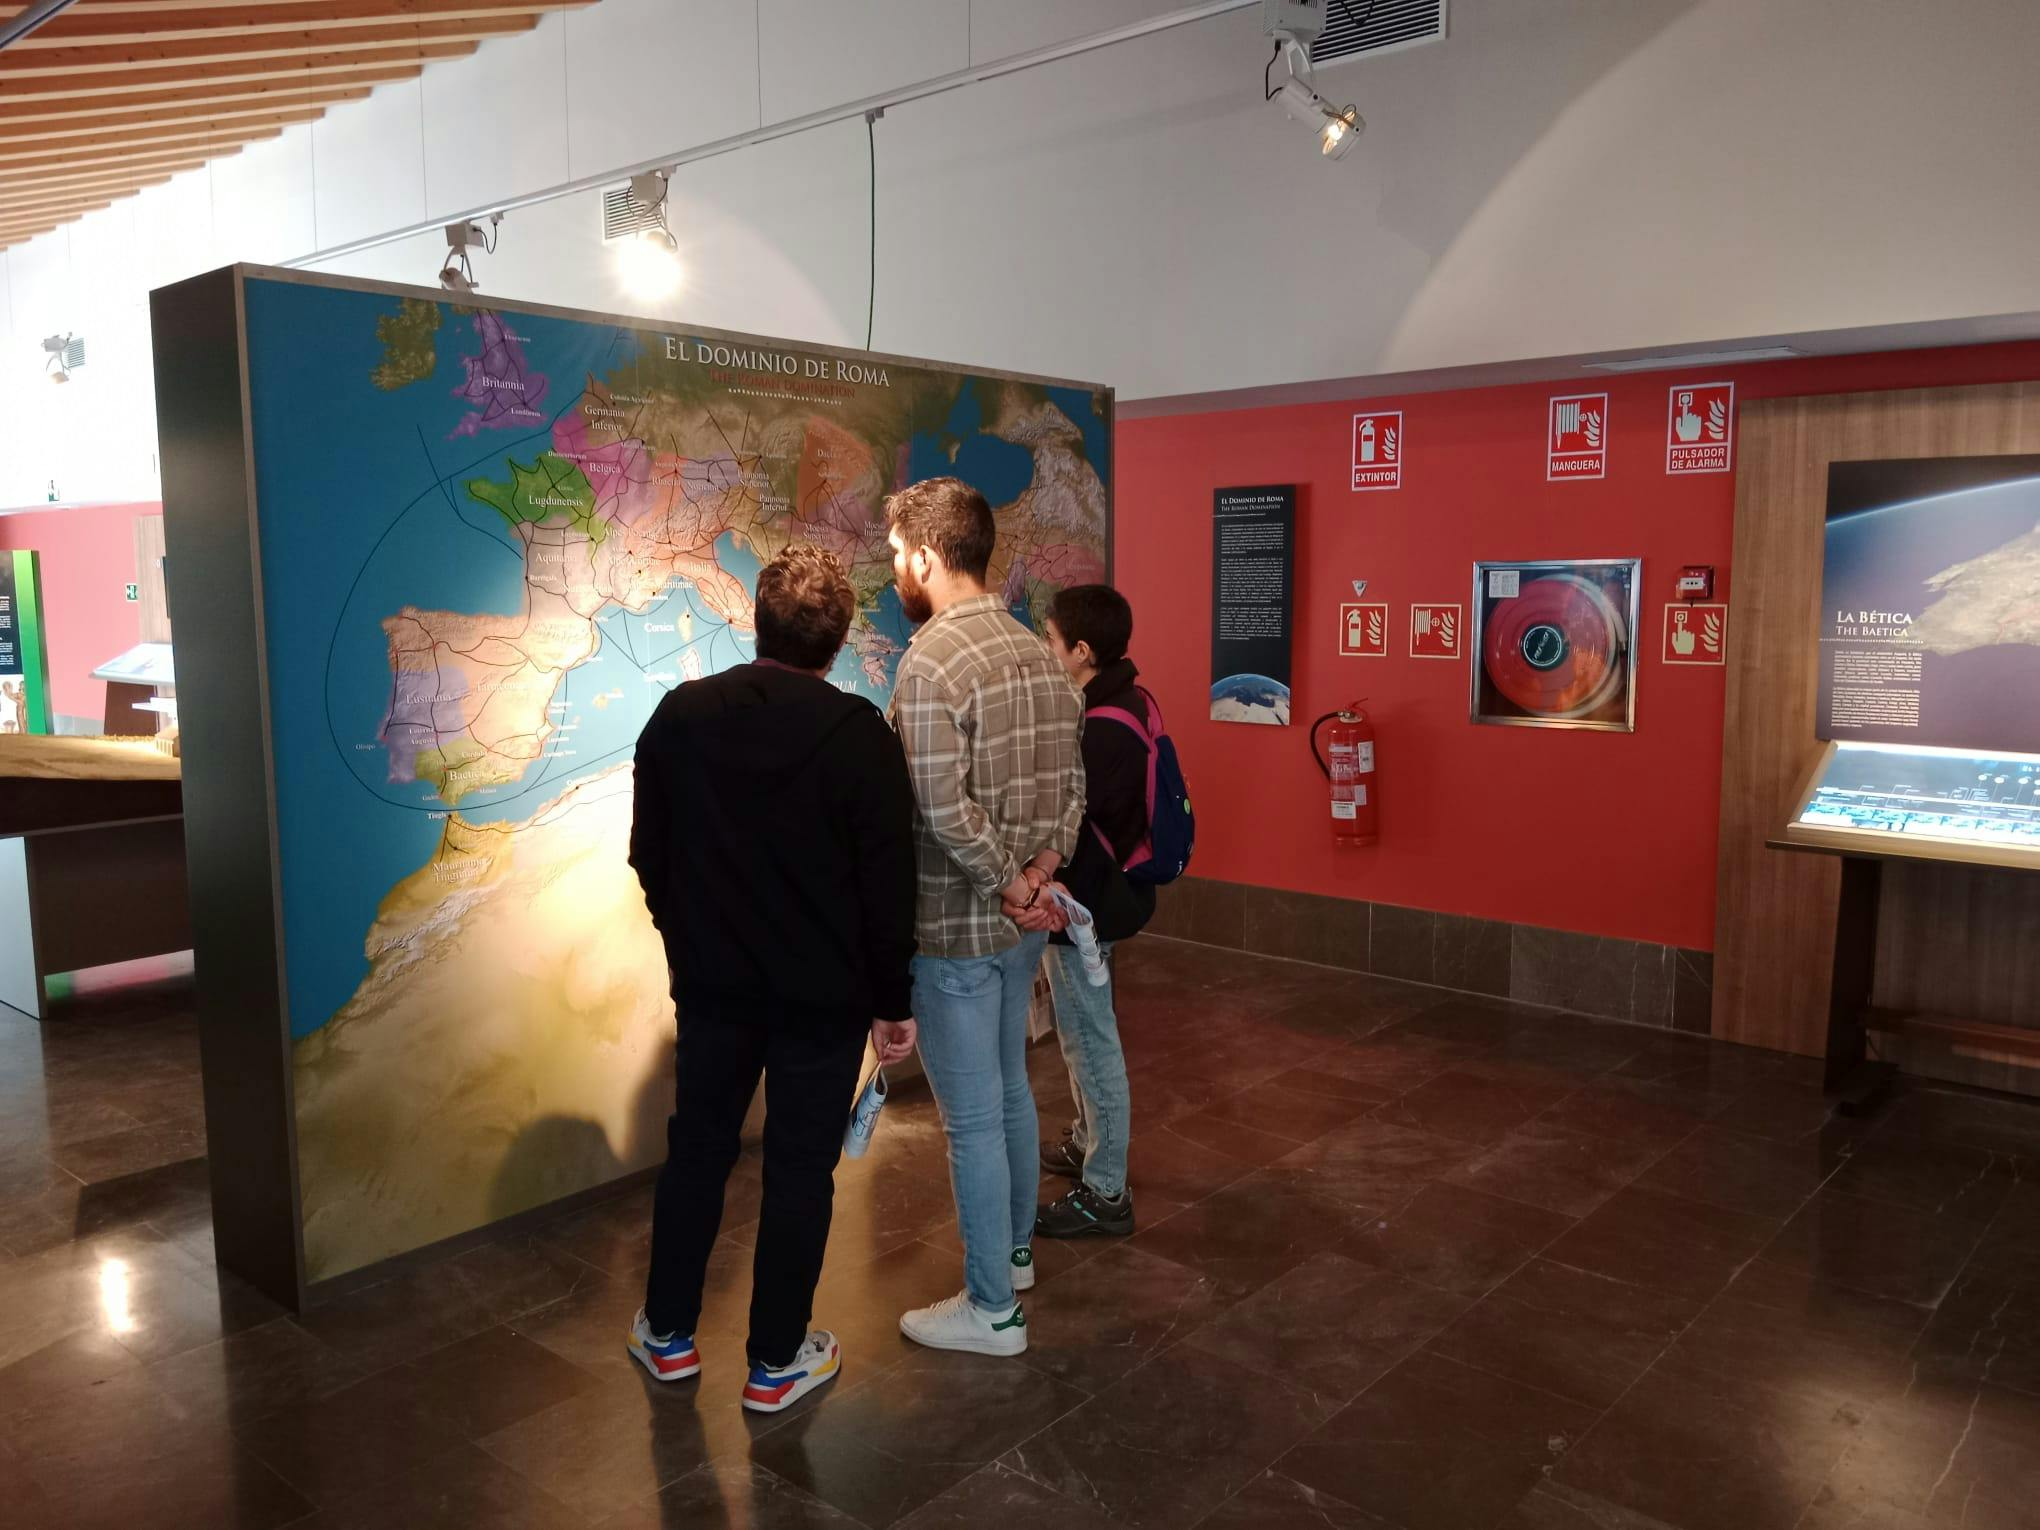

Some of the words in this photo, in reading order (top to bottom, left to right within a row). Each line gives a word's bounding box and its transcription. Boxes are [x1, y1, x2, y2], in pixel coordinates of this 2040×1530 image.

[664, 336, 690, 362] EL
[698, 344, 798, 375] DOMINIO
[805, 359, 829, 379] DE
[837, 360, 890, 387] ROMA
[482, 377, 525, 391] Britannia
[709, 368, 732, 385] THE
[737, 372, 779, 389] ROMAN
[784, 380, 856, 399] DOMINATION
[584, 405, 625, 418] Germania
[592, 420, 623, 432] Inferior
[1672, 447, 1726, 460] PULSADOR
[589, 463, 620, 475] Belgica
[1551, 458, 1601, 473] MANGUERA
[1671, 459, 1684, 470] DE
[1686, 457, 1725, 470] ALARMA
[1355, 471, 1397, 484] EXTINTOR
[529, 495, 583, 507] Lugdunensis
[1837, 610, 1855, 623] LA
[1859, 609, 1913, 624] BÉTICA
[1836, 625, 1858, 635] THE
[1862, 626, 1909, 637] BAETICA
